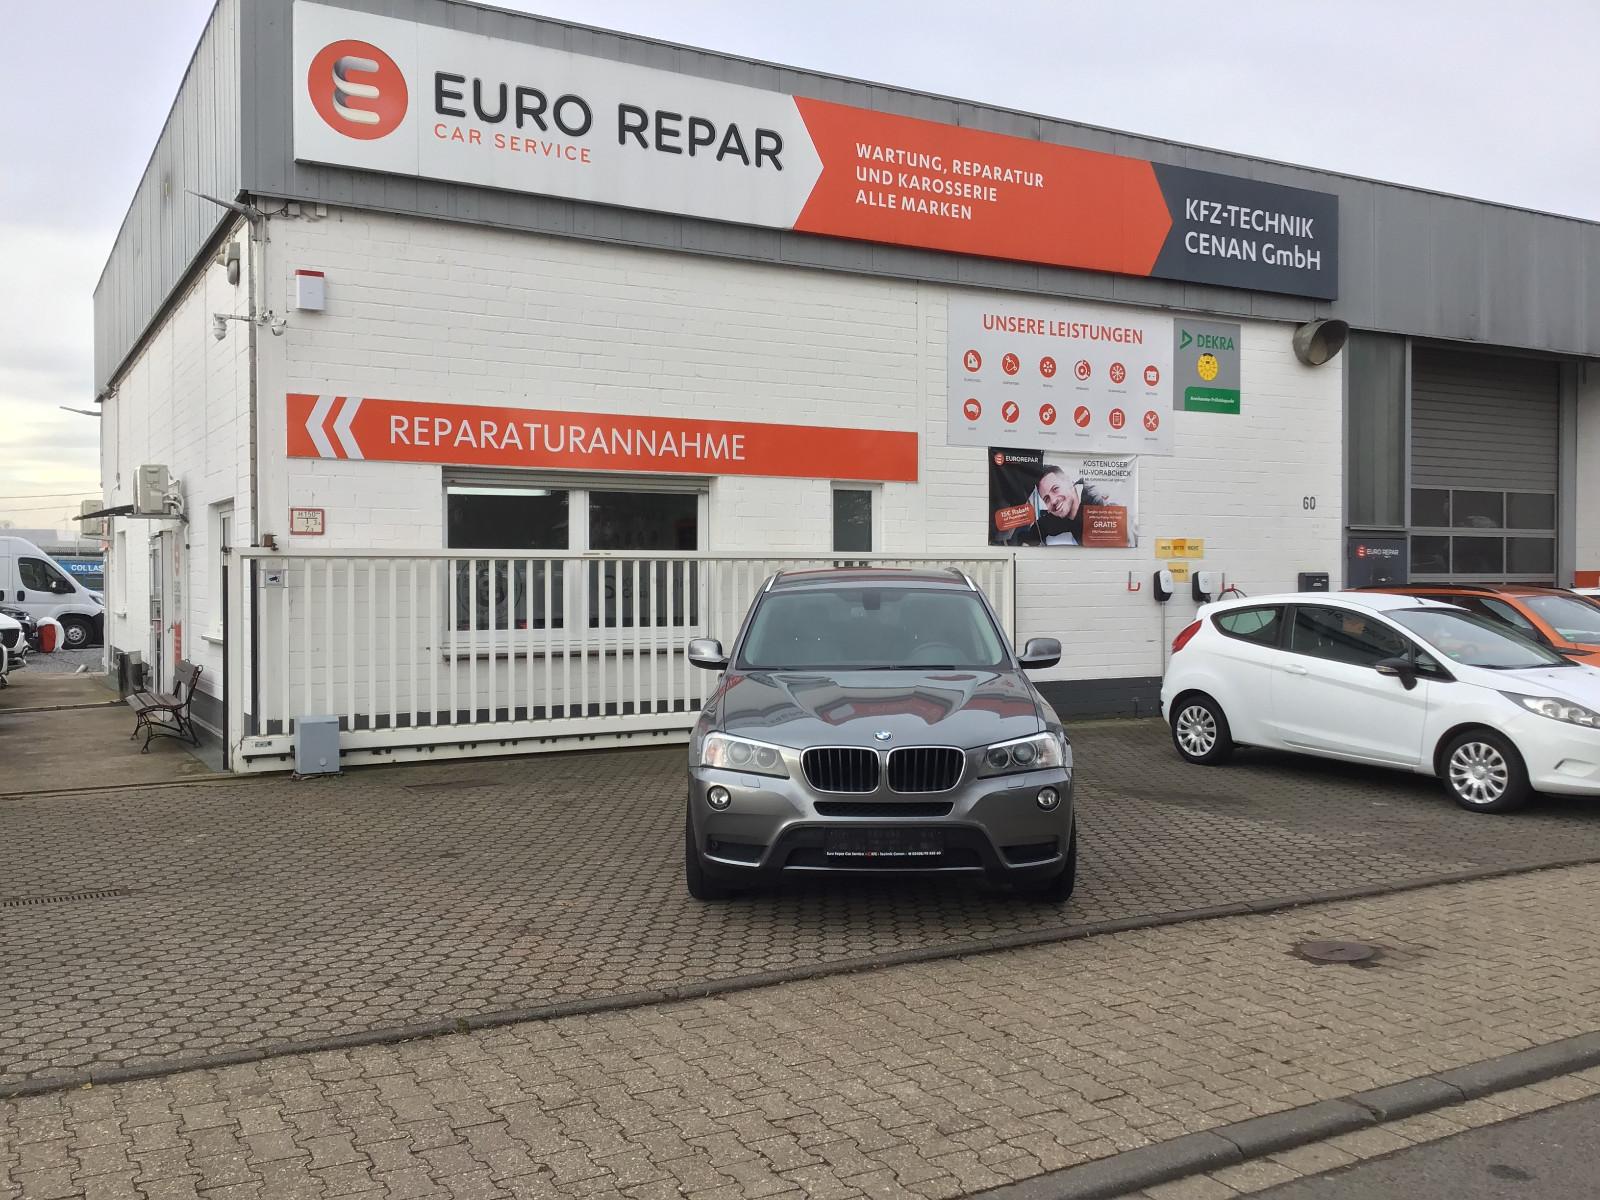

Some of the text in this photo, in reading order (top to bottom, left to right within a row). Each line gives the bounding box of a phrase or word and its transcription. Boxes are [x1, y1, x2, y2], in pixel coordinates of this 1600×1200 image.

[434, 70, 784, 171] EURO REPAR
[434, 123, 592, 164] CAR SERVICE
[855, 142, 1044, 188] WARTUNG, REPARATUR
[855, 165, 998, 203] UND KAROSSERIE
[855, 189, 972, 220] ALLE MARKEN
[1184, 197, 1314, 240] KFZ-TECHNIK
[1184, 230, 1322, 271] CENAN GmbH
[983, 313, 1143, 344] UNSERE LEISTUNGEN
[1197, 333, 1235, 351] DEKRA
[390, 414, 746, 461] REPARATURANNAHME
[1079, 469, 1132, 477] HU-VORABCHECK
[1083, 459, 1128, 468] KOSTENLOSER
[1303, 496, 1316, 510] 60
